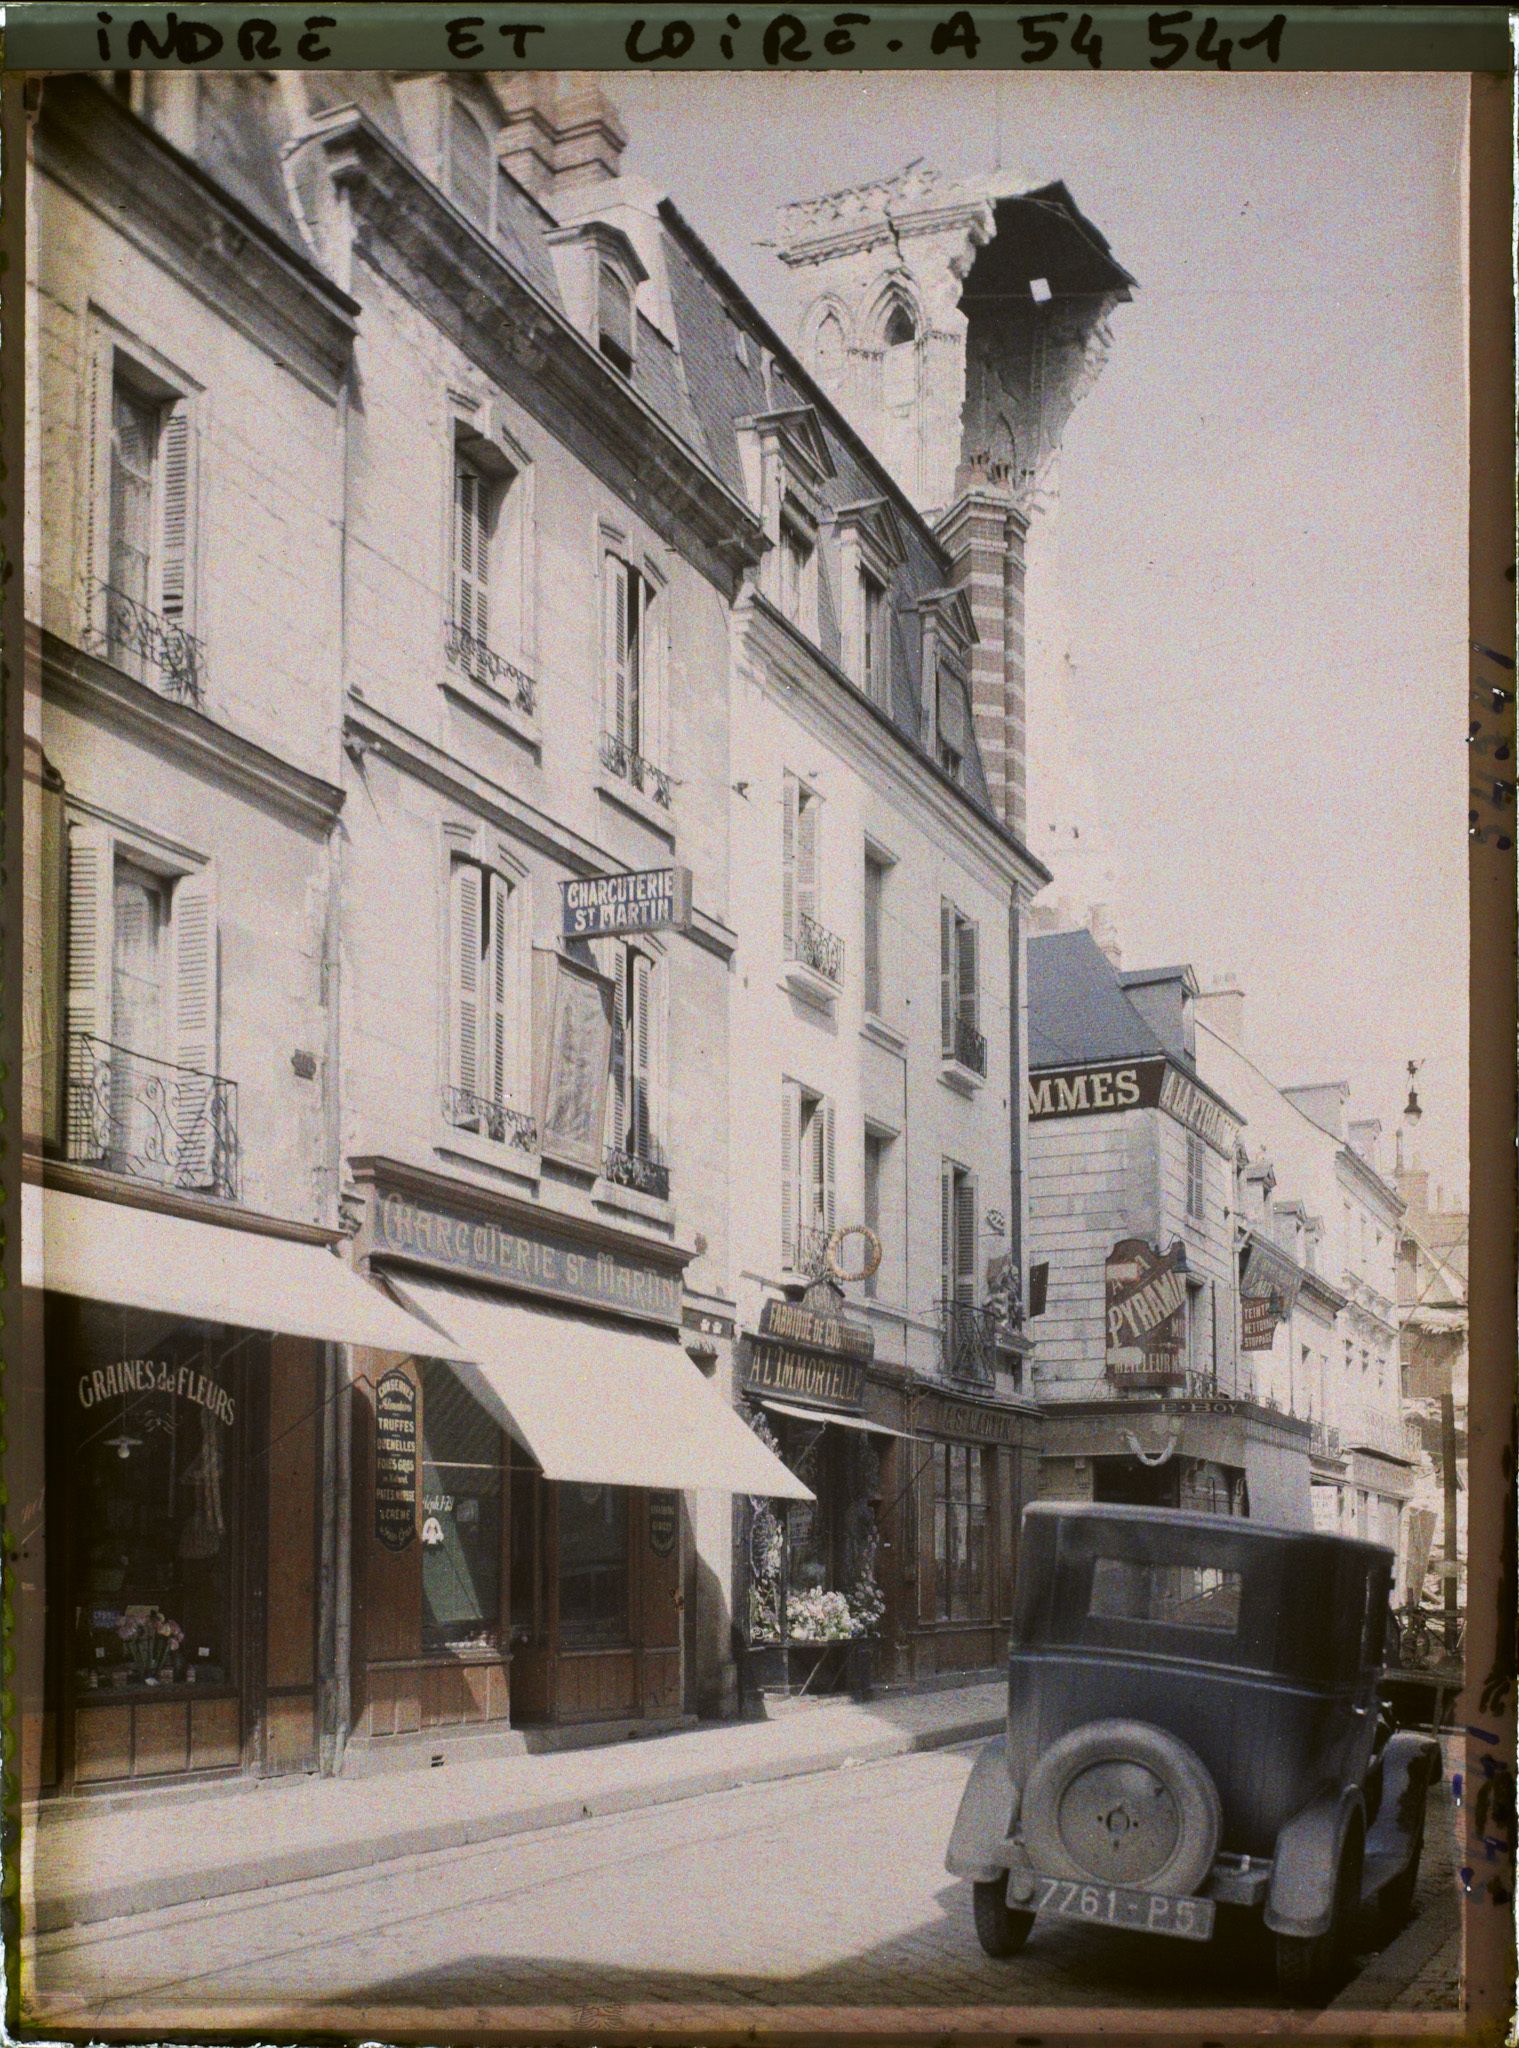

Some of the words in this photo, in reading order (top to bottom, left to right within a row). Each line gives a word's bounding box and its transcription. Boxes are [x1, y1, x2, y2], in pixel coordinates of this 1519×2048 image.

[445, 16, 545, 60] ET
[931, 14, 981, 59] A
[567, 870, 674, 909] CHARCUTERIE
[599, 898, 669, 929] MARTIN
[382, 1193, 557, 1281] CHARCUTERIE
[597, 1252, 684, 1308] MARTIN
[78, 1360, 156, 1409] GRAINES
[177, 1366, 236, 1426] FLEURS
[377, 1417, 415, 1434] TRUFFES
